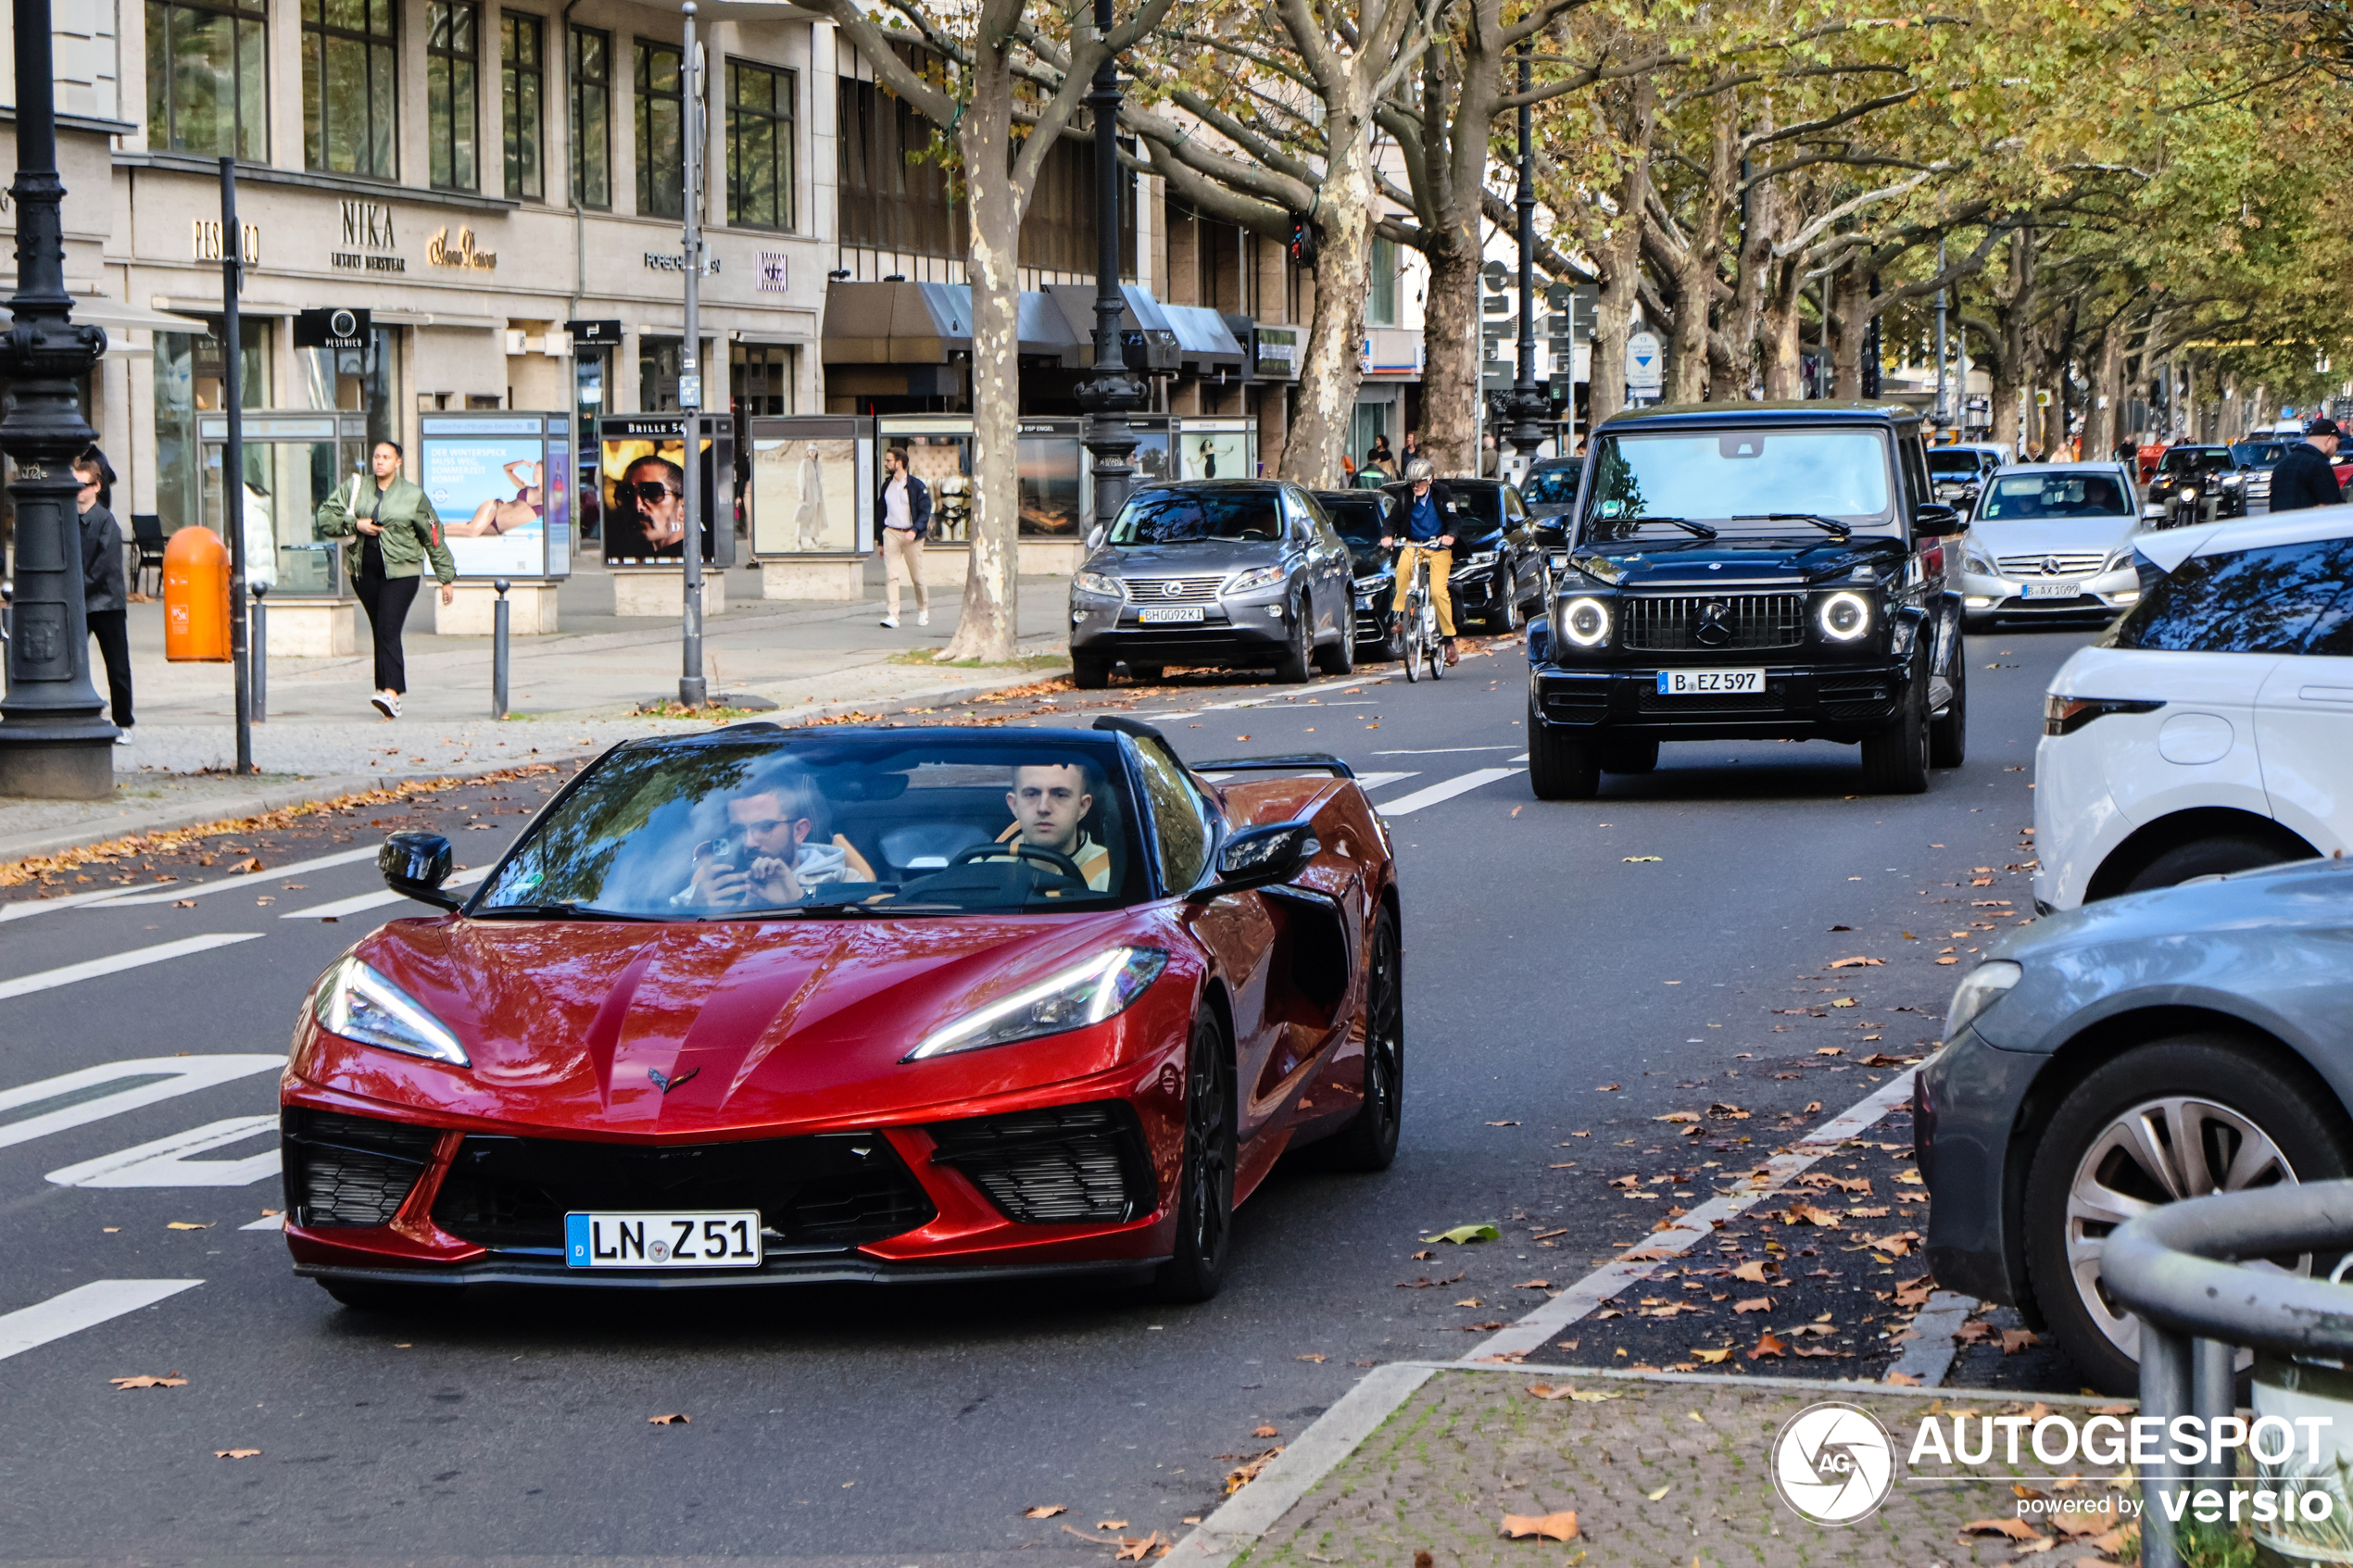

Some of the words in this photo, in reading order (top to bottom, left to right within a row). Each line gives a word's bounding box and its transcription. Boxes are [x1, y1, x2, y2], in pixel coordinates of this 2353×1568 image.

[341, 201, 396, 249] NIKA
[331, 252, 361, 270] LUXURY
[325, 337, 362, 348] PESERICO
[628, 422, 667, 433] BRILLE
[431, 448, 448, 457] DER
[449, 448, 508, 457] WINTERSPECK
[431, 458, 457, 466] MUSS
[431, 466, 486, 475] SOMMERZEIT
[2028, 586, 2034, 596] B
[2040, 585, 2052, 596] AX
[2055, 584, 2079, 596] 1099
[1675, 674, 1686, 691] B
[1698, 674, 1720, 691] EZ
[1724, 672, 1756, 690] 597
[593, 1221, 645, 1260] LN
